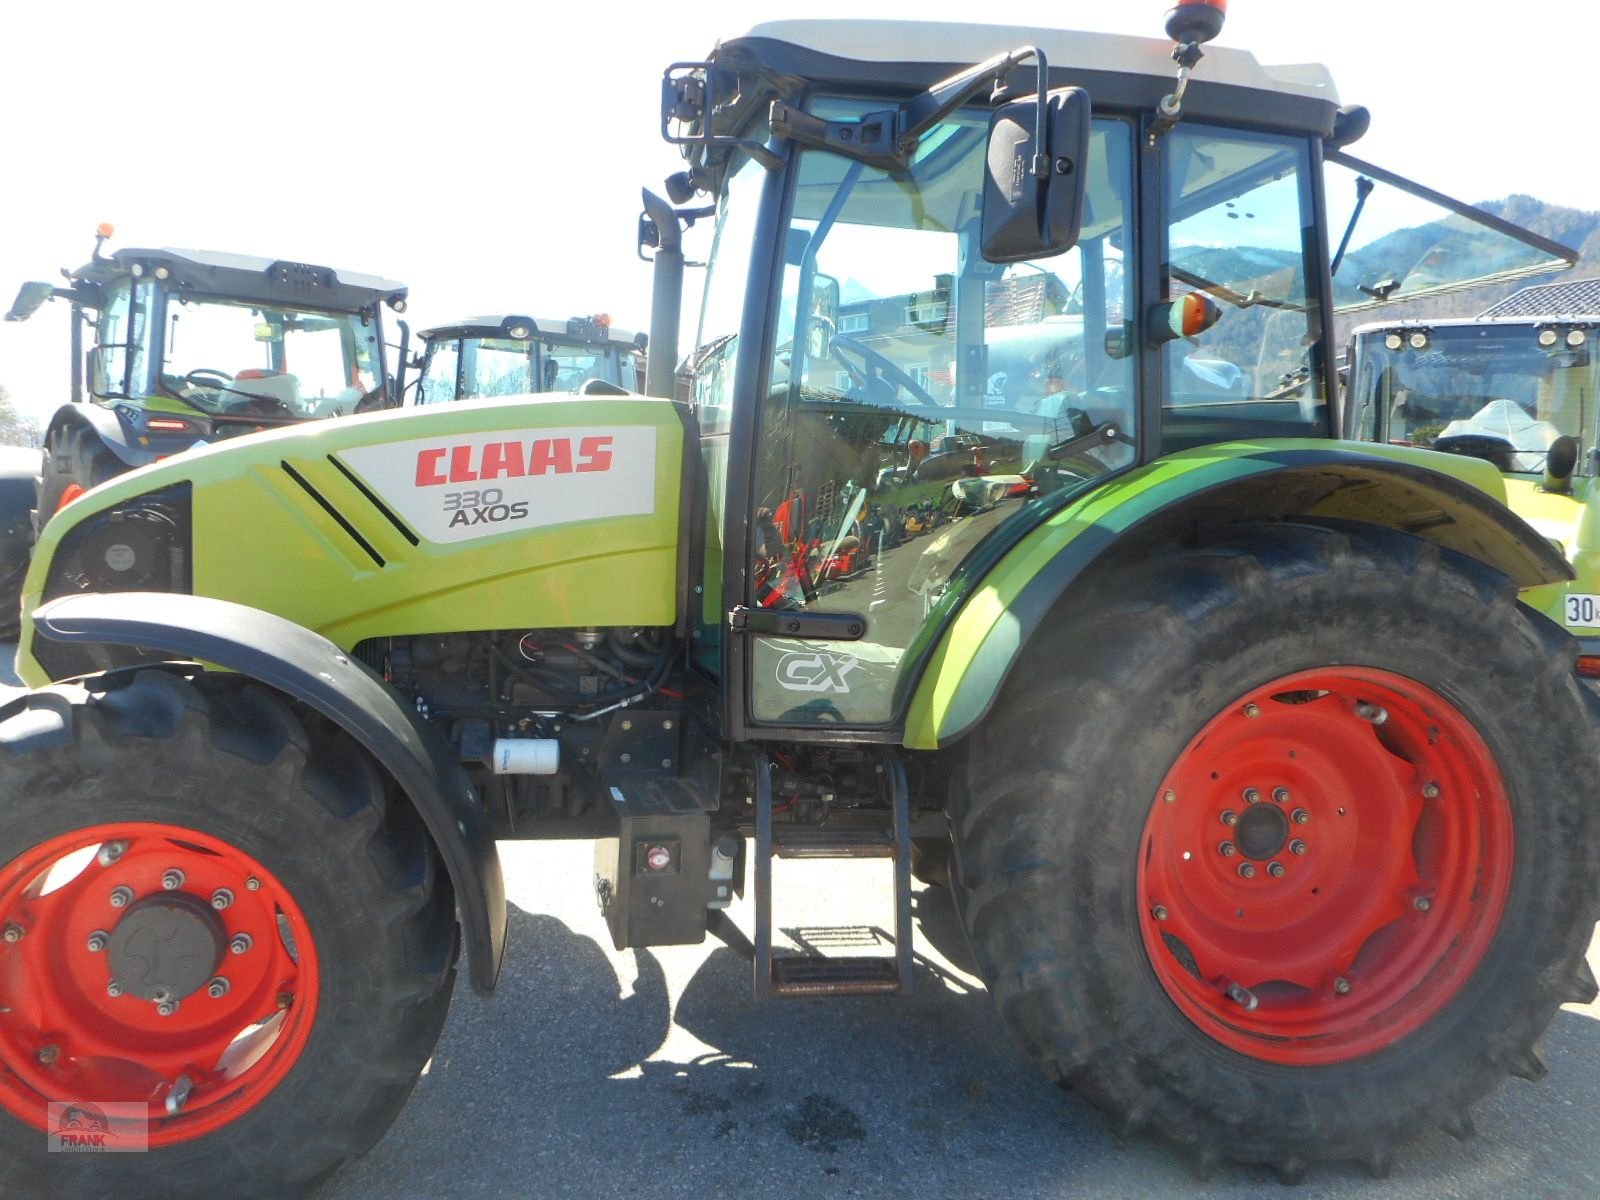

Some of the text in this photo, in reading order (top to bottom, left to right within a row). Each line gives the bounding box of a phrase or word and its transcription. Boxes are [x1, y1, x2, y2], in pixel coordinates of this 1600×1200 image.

[415, 436, 613, 487] CLAAS
[443, 488, 503, 512] 330
[448, 502, 529, 528] AXOS
[776, 652, 859, 692] CX
